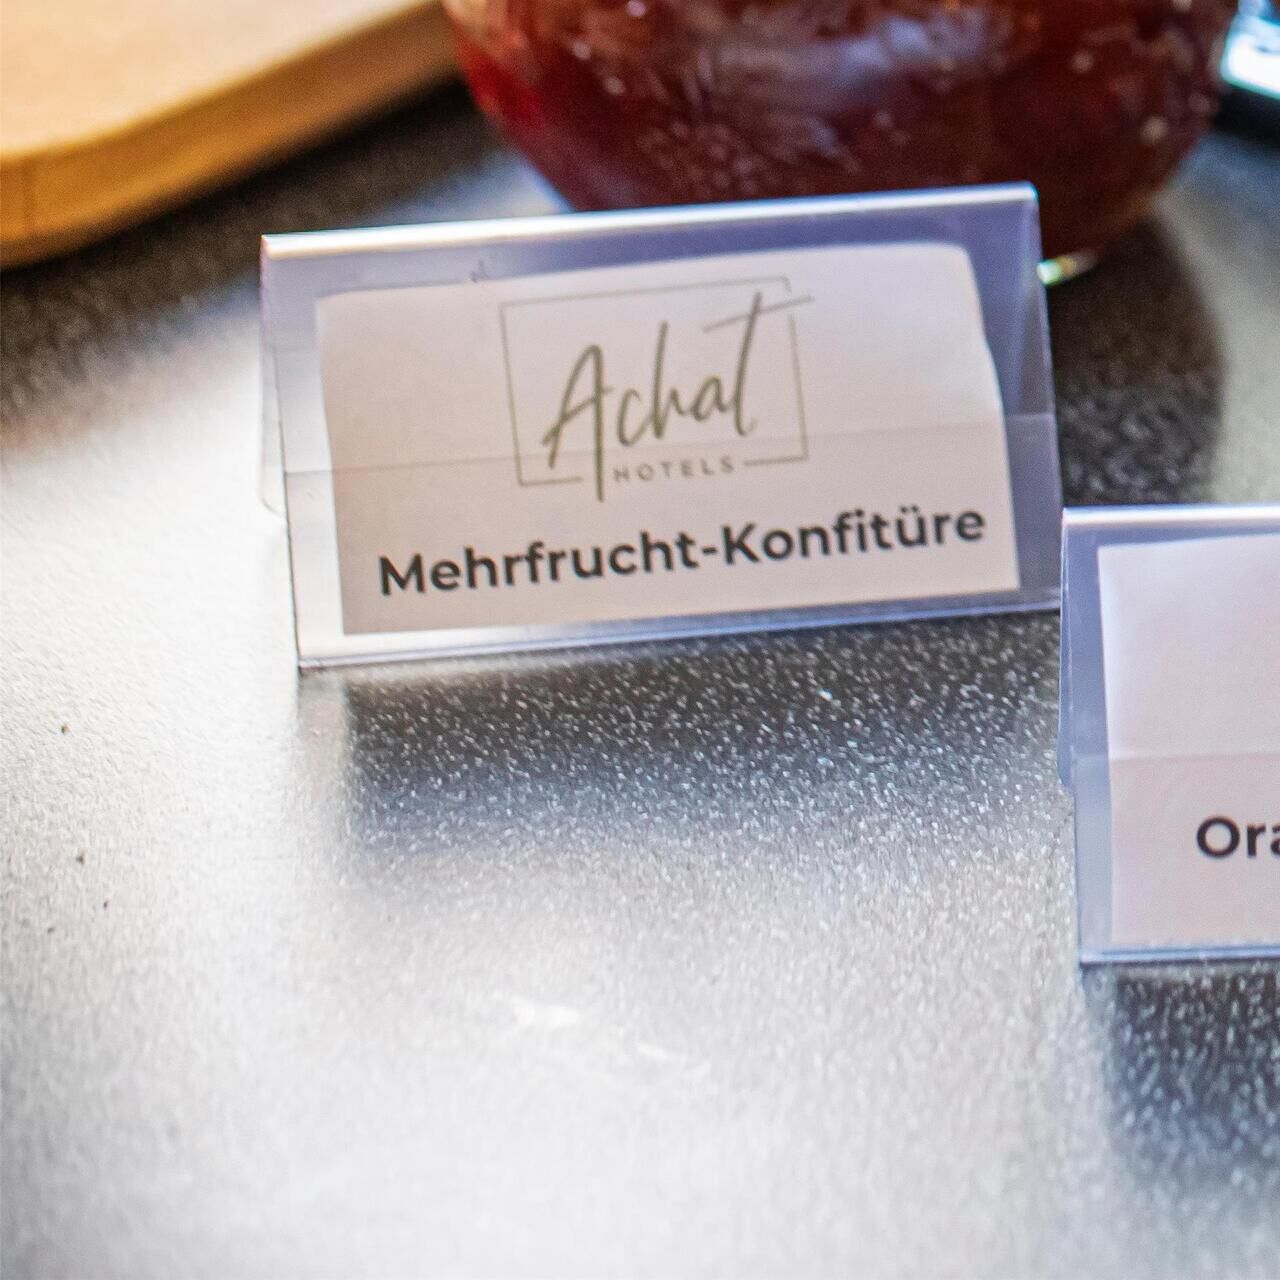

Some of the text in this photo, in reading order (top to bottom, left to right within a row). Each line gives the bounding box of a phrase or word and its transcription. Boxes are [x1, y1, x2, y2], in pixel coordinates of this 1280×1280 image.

[541, 292, 814, 502] Achat
[613, 457, 736, 483] HOTELS
[378, 507, 986, 596] Mehrfrucht-Konfitüre
